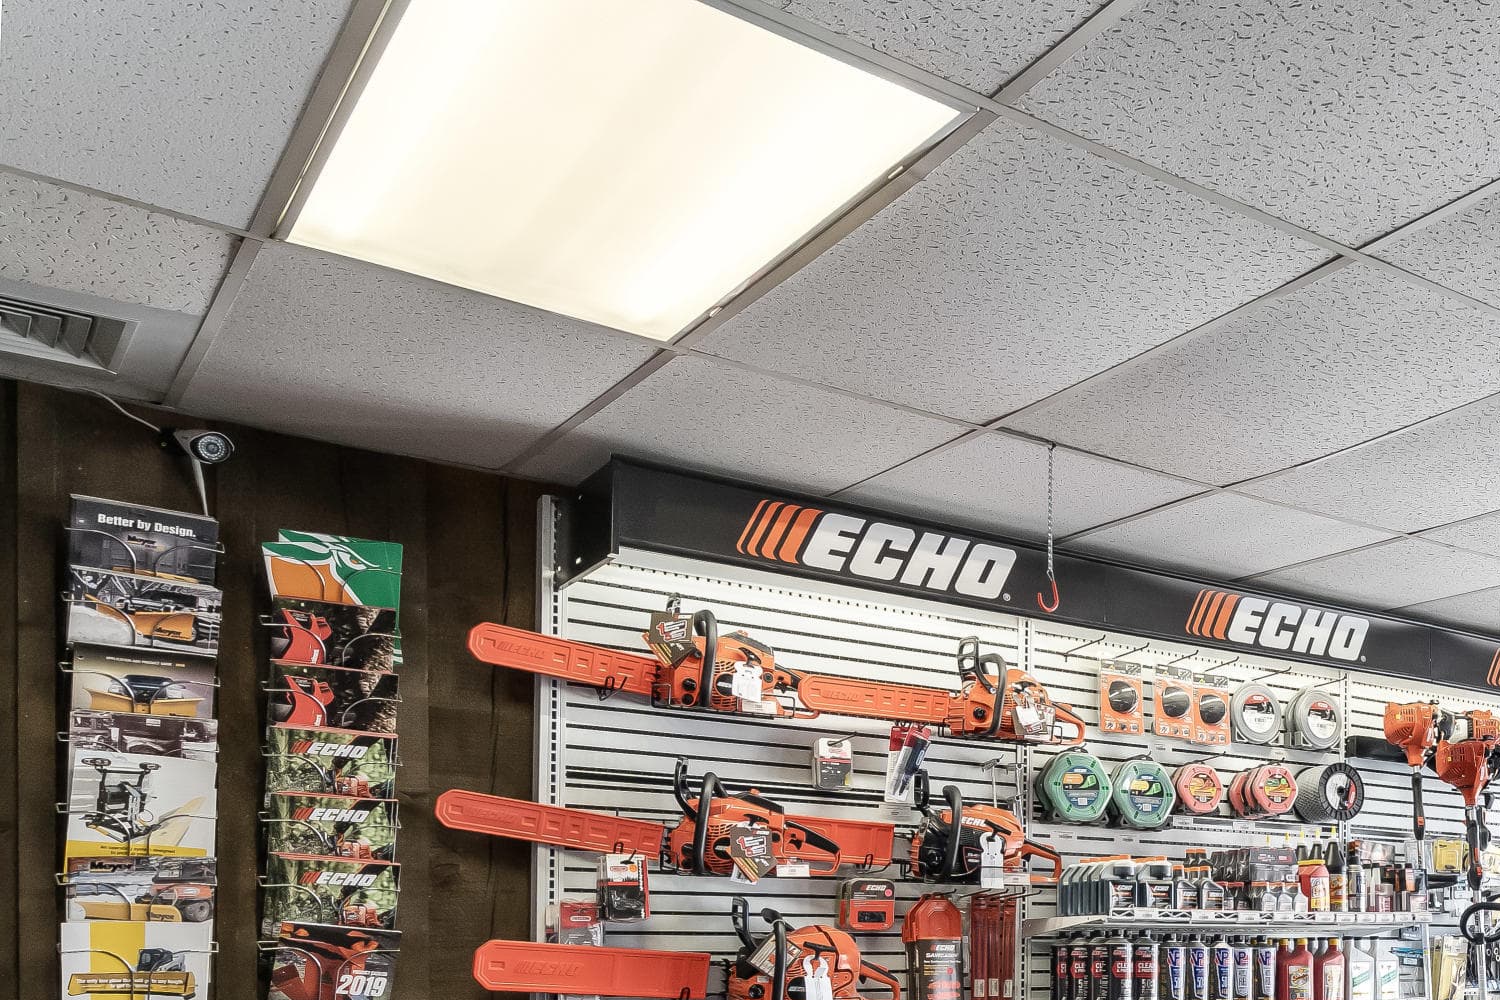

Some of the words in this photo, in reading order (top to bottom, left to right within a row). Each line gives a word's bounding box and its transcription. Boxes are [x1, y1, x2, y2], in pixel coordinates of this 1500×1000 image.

[97, 513, 134, 528] Better
[137, 519, 152, 531] by
[154, 522, 196, 538] Design.
[802, 513, 1016, 600] ECHO
[1228, 597, 1370, 662] ECHO
[307, 743, 369, 758] ECHO
[309, 808, 370, 823] ECHO
[90, 861, 133, 872] Meyer
[316, 872, 377, 887] ECHO
[336, 974, 388, 997] 2019
